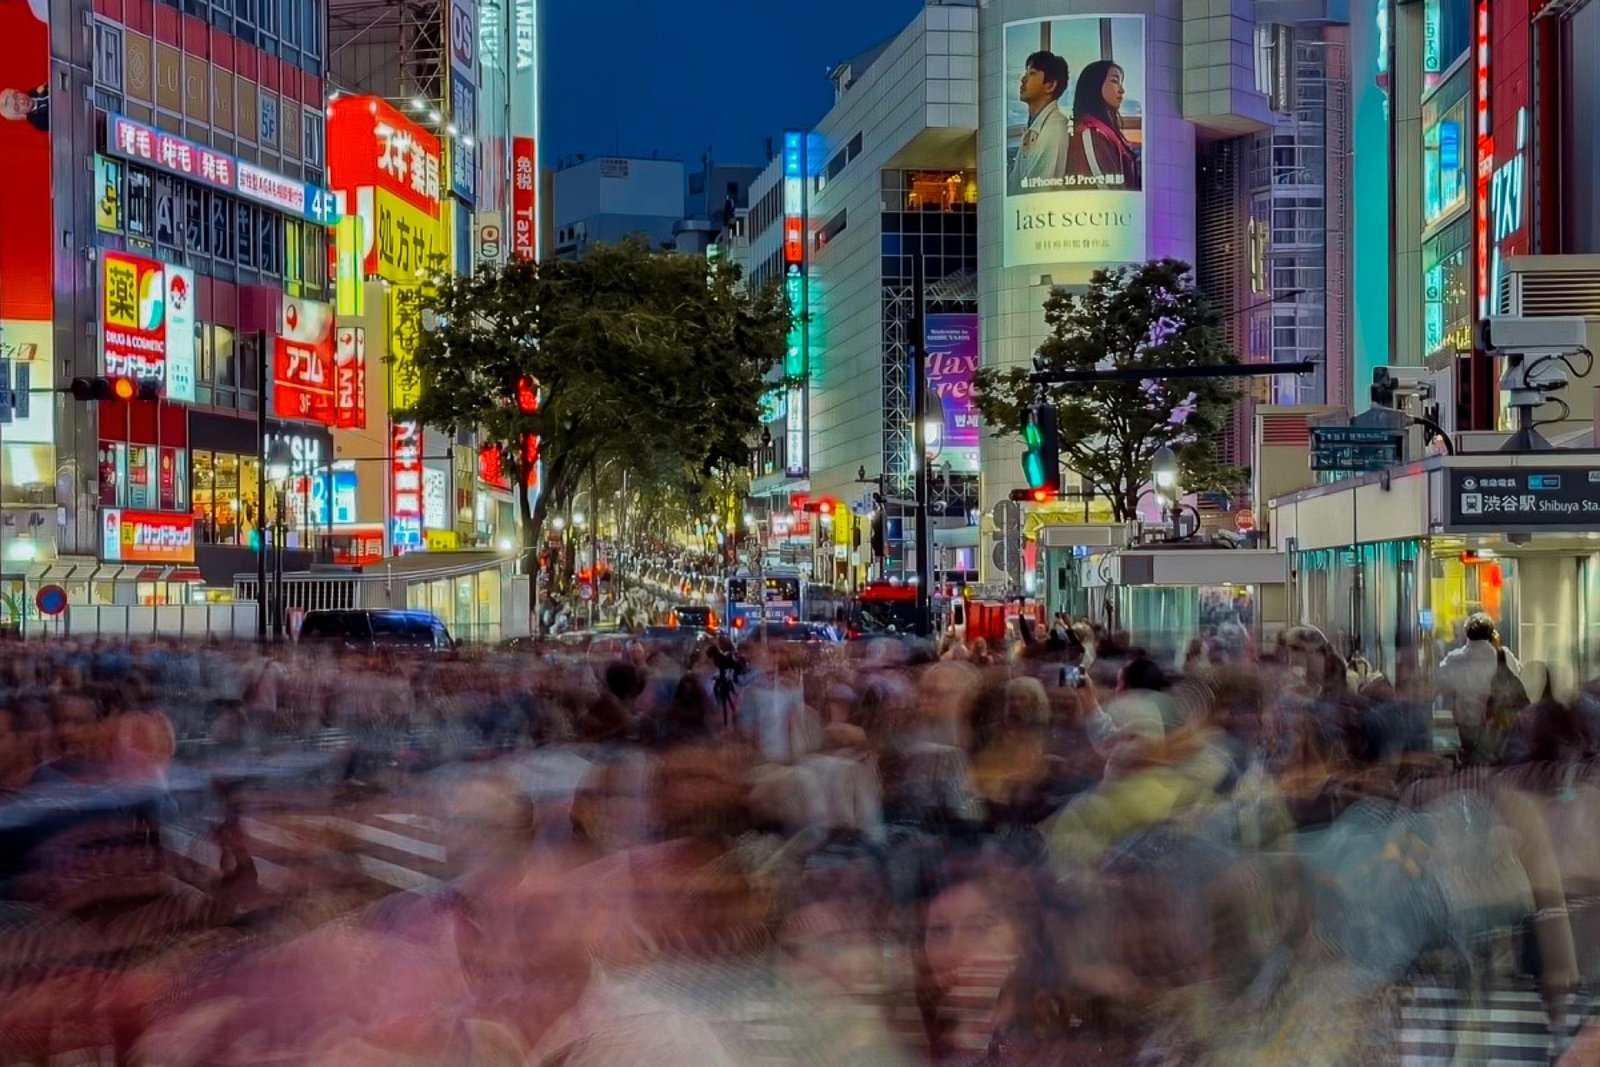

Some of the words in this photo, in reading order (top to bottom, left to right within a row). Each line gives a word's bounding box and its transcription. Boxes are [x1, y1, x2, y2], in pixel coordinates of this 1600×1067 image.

[453, 5, 472, 60] OS
[1029, 177, 1063, 187] iPhone
[1065, 175, 1075, 185] 16
[311, 189, 333, 222] 4F
[1016, 209, 1055, 231] last
[1062, 210, 1131, 227] scene
[482, 227, 498, 257] OS
[516, 207, 533, 262] TaxF
[109, 265, 134, 321] 薬
[287, 346, 324, 384] アコム
[299, 393, 311, 414] 3F
[1483, 495, 1536, 512] 渋谷駅
[1539, 500, 1579, 514] Shibuya
